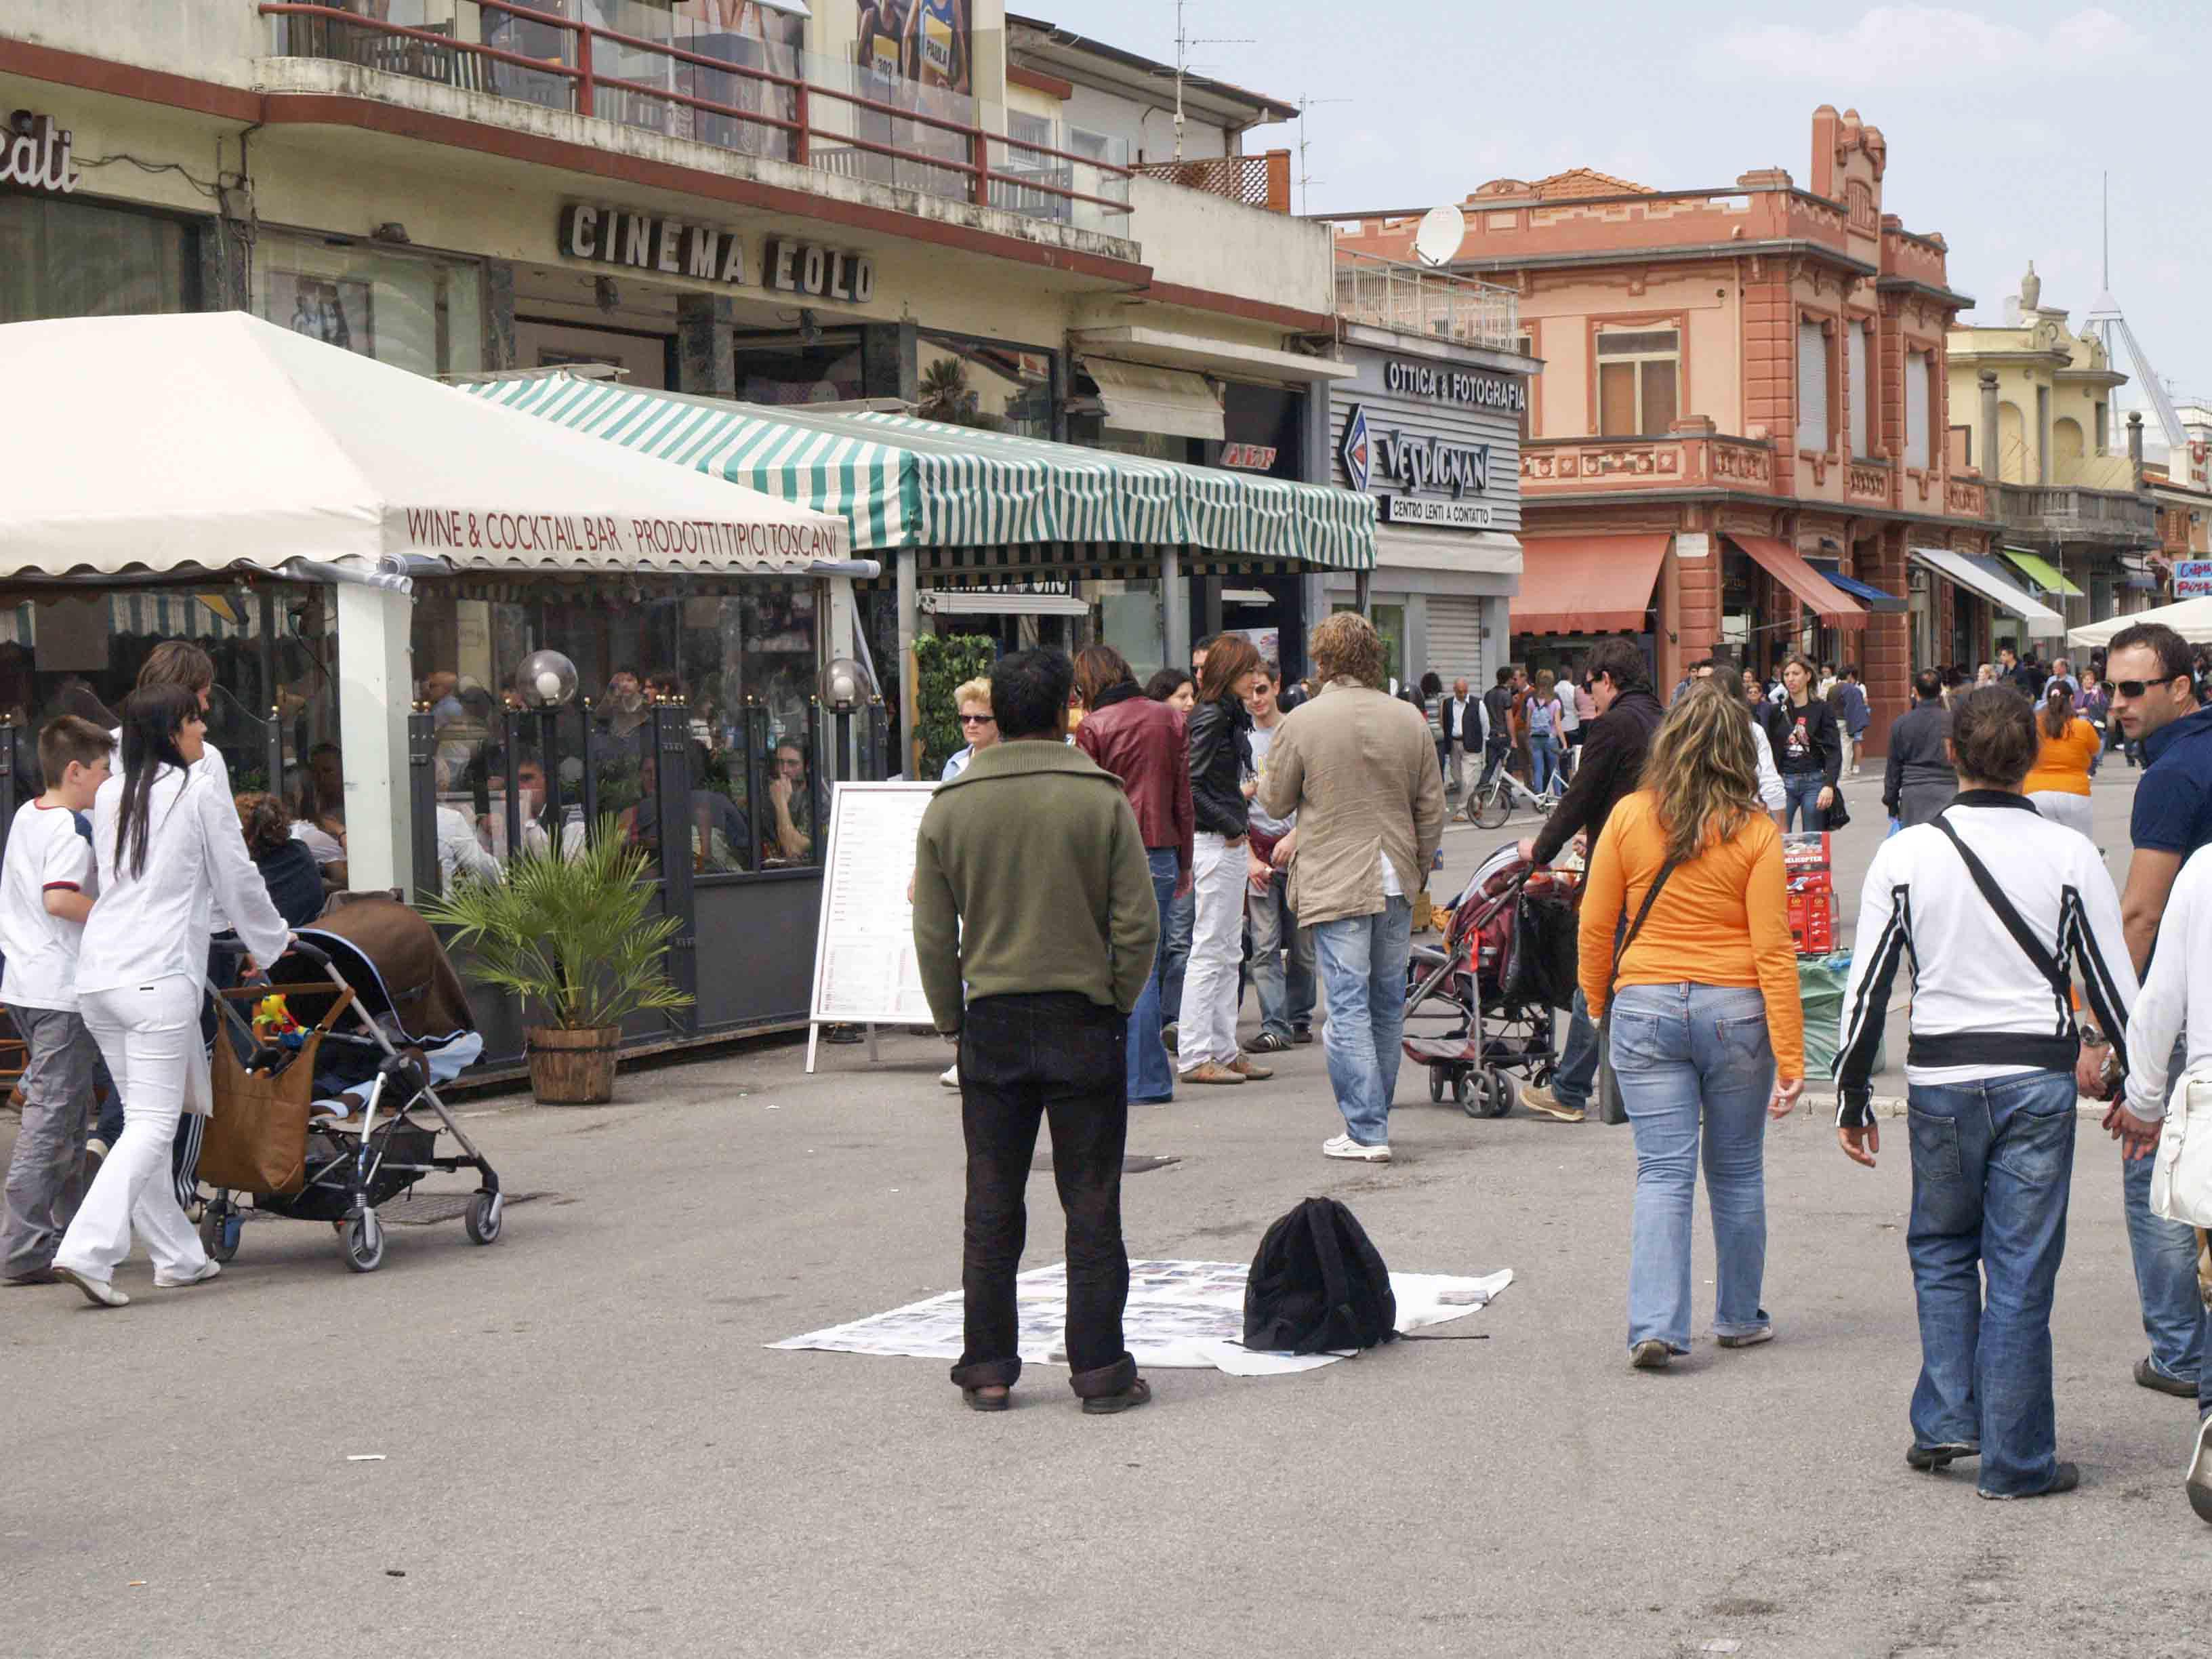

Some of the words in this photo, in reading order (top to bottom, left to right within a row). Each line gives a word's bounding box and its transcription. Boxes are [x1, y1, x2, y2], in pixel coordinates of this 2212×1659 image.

[571, 204, 745, 284] CINEMA
[774, 239, 874, 303] EOLO
[1389, 361, 1437, 396] OTTICA
[1452, 373, 1525, 411] FOTOGRAFIA
[407, 507, 464, 547] WINE
[468, 512, 483, 548] &
[485, 512, 583, 551] COCKTAIL
[583, 516, 623, 552] BAR
[632, 518, 723, 555] PRODOTTI
[721, 523, 769, 556] TIPICI
[767, 523, 838, 558] TOSCANI
[1393, 499, 1422, 518] CENTRO
[1425, 504, 1444, 520] LENTI
[1446, 507, 1452, 522] A
[1453, 506, 1489, 525] CONTATTO
